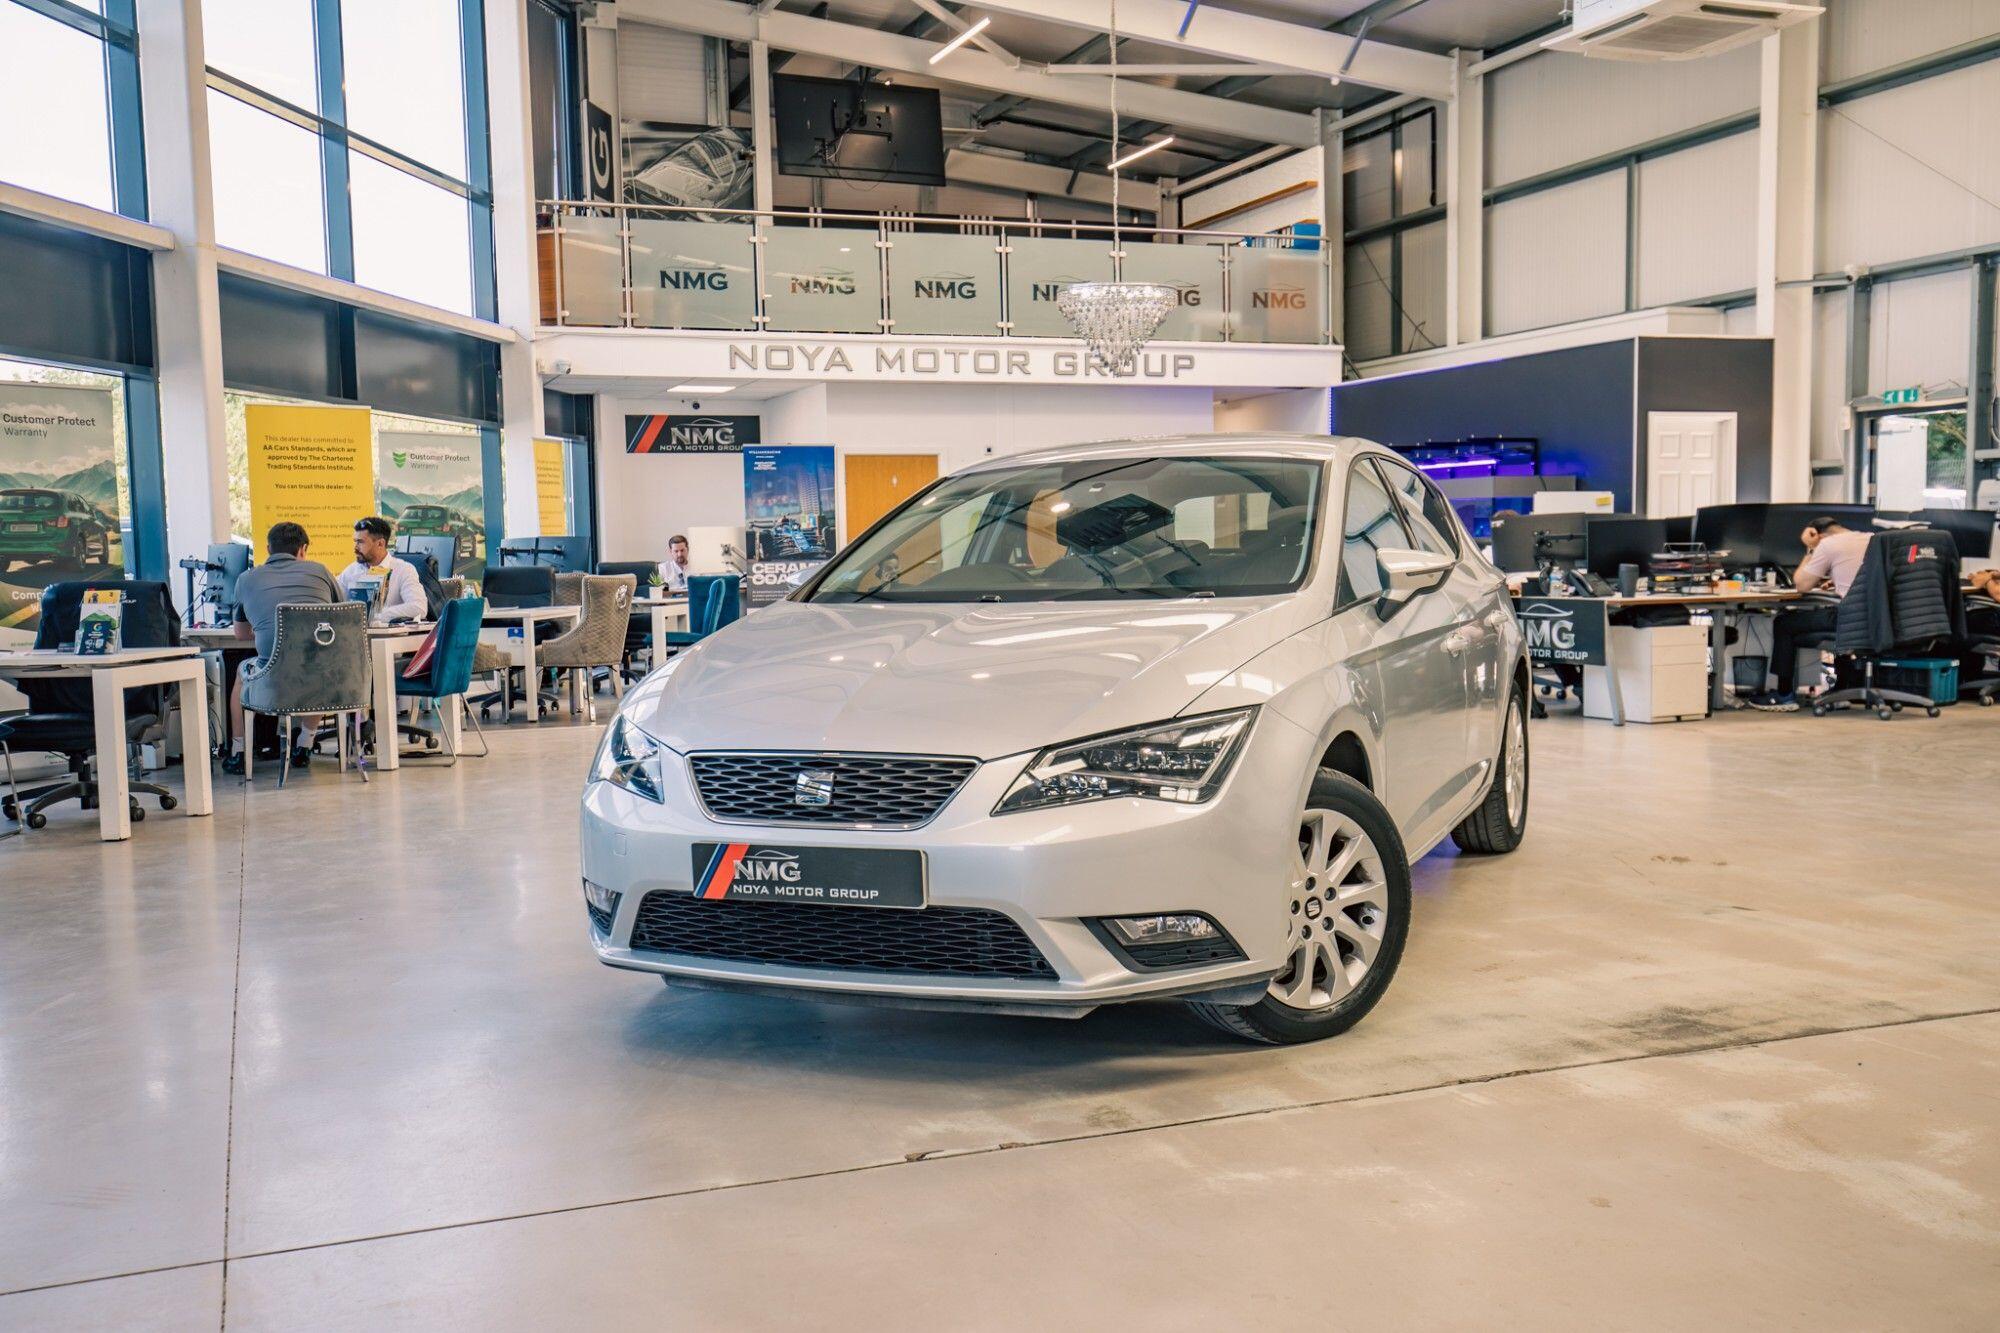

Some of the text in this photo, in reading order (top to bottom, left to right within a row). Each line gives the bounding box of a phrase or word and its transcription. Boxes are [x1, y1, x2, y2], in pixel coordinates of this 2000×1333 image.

[659, 269, 729, 291] NMG
[790, 276, 856, 295] NMG
[914, 279, 977, 300] NMG
[1252, 291, 1306, 310] NMG
[729, 344, 853, 372] NOYA
[875, 347, 1031, 375] MOTOR
[3, 413, 96, 427] Customer Protect
[4, 427, 48, 438] Warranty
[670, 427, 735, 445] NMG
[410, 453, 470, 462] Customer Protect
[267, 463, 292, 471] Trading
[1554, 650, 1589, 660] GROUP
[732, 859, 802, 882] NMG
[733, 883, 879, 900] NOYA MOTOR GROUP
